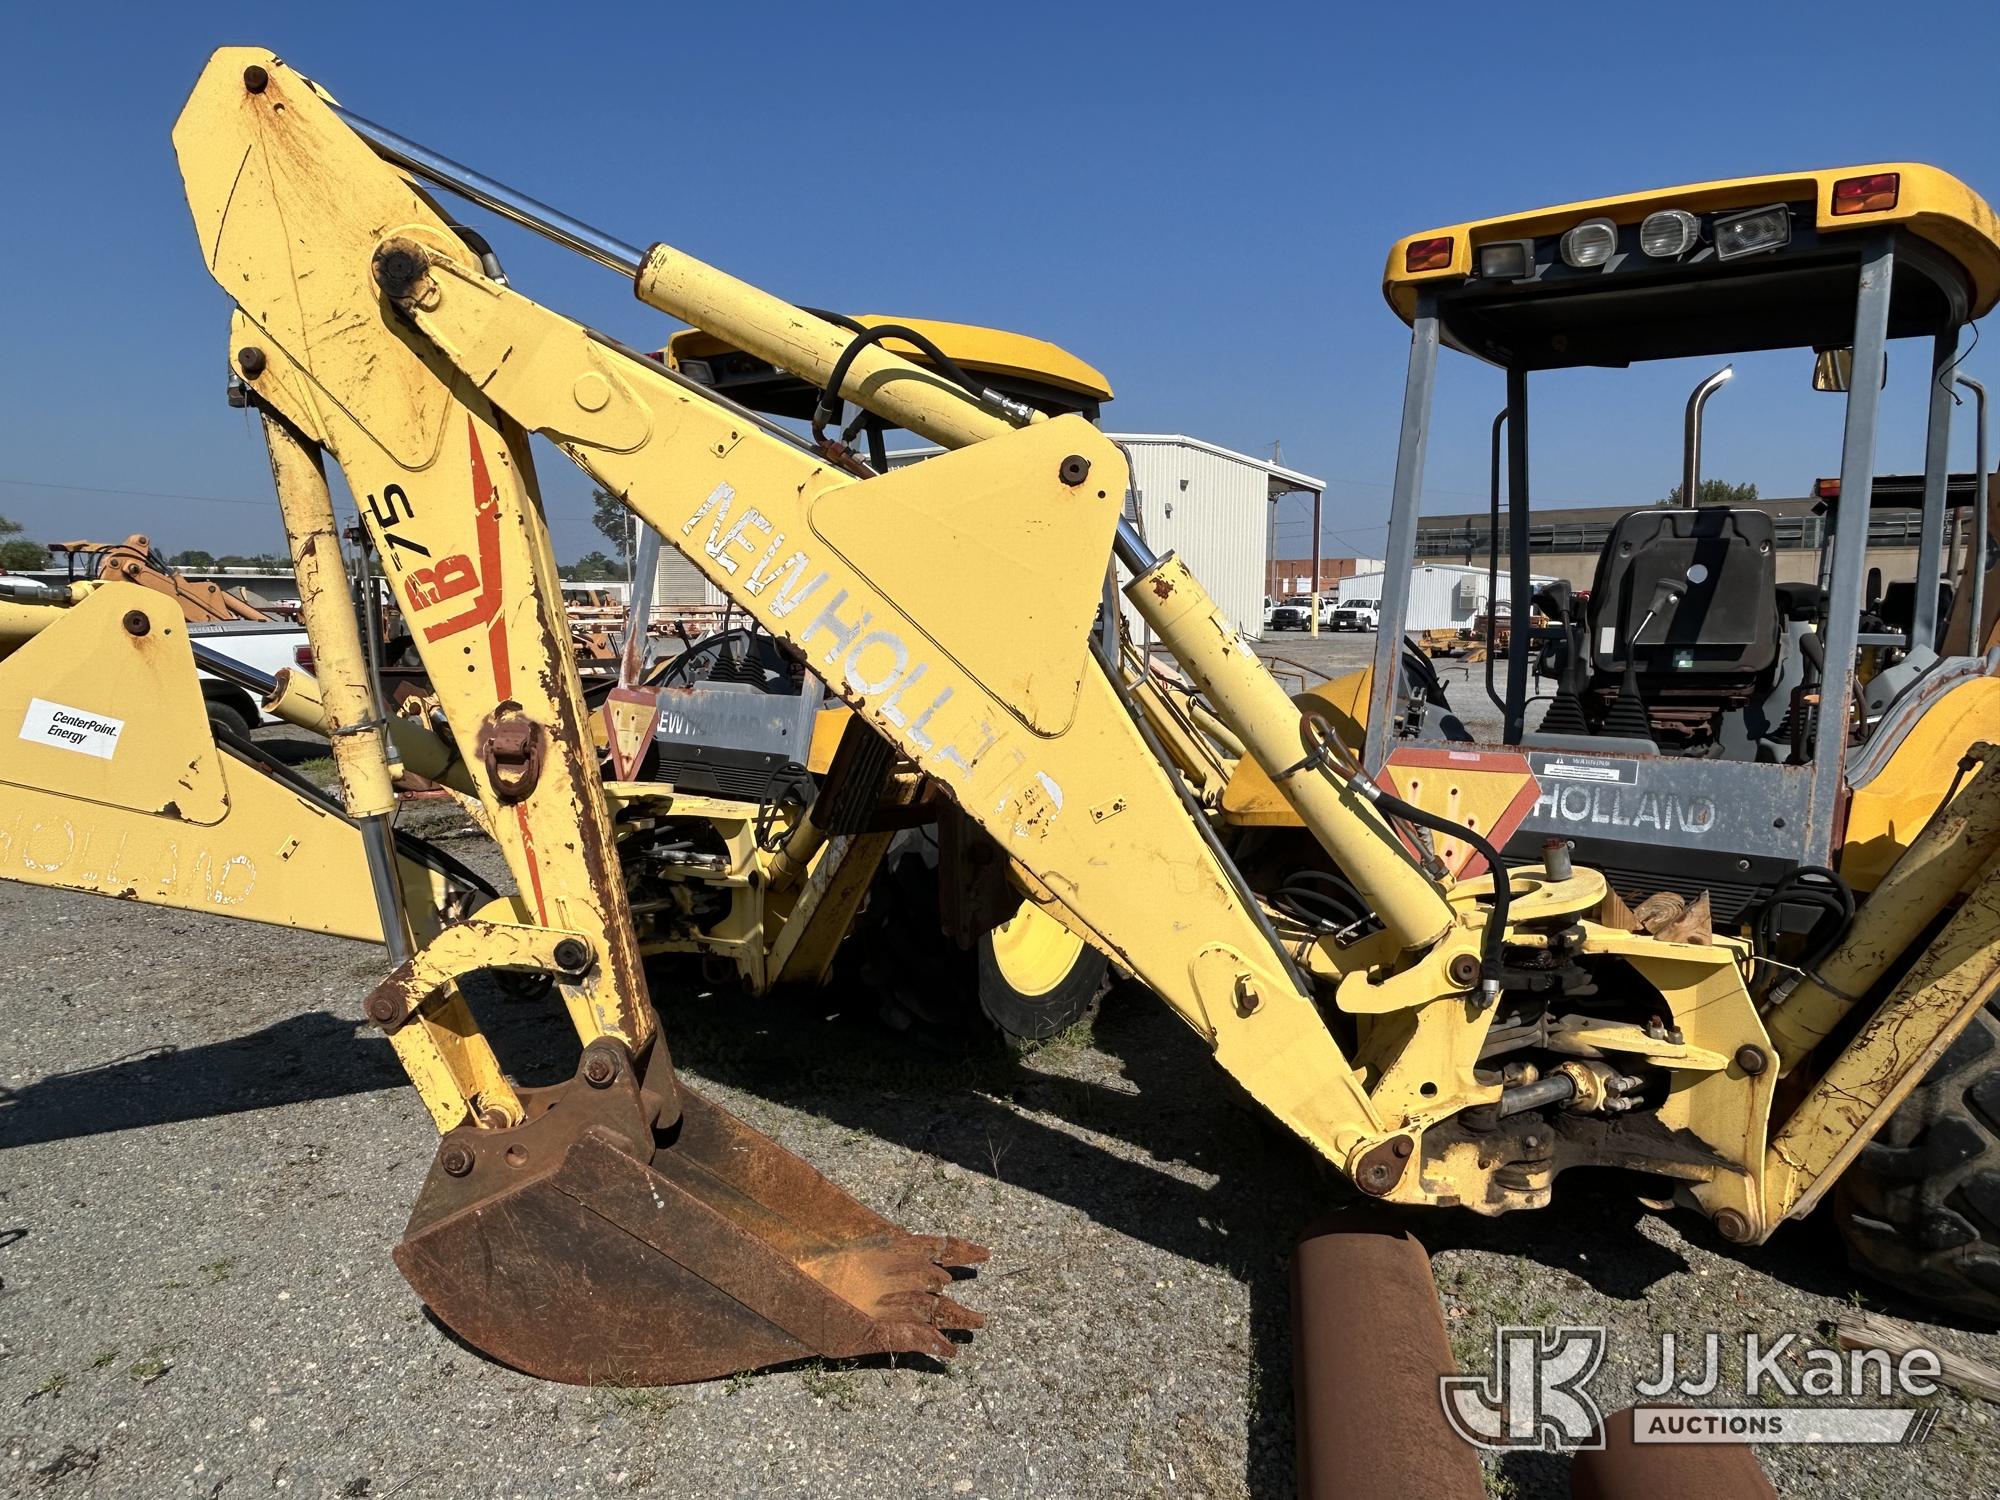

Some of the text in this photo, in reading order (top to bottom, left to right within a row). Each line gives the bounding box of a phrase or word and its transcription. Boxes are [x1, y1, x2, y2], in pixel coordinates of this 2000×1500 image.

[681, 481, 829, 619] NEW
[47, 724, 87, 745] Energy
[52, 711, 117, 737] CenterPoint
[656, 710, 684, 734] EW
[1532, 783, 1716, 834] HOLLAND
